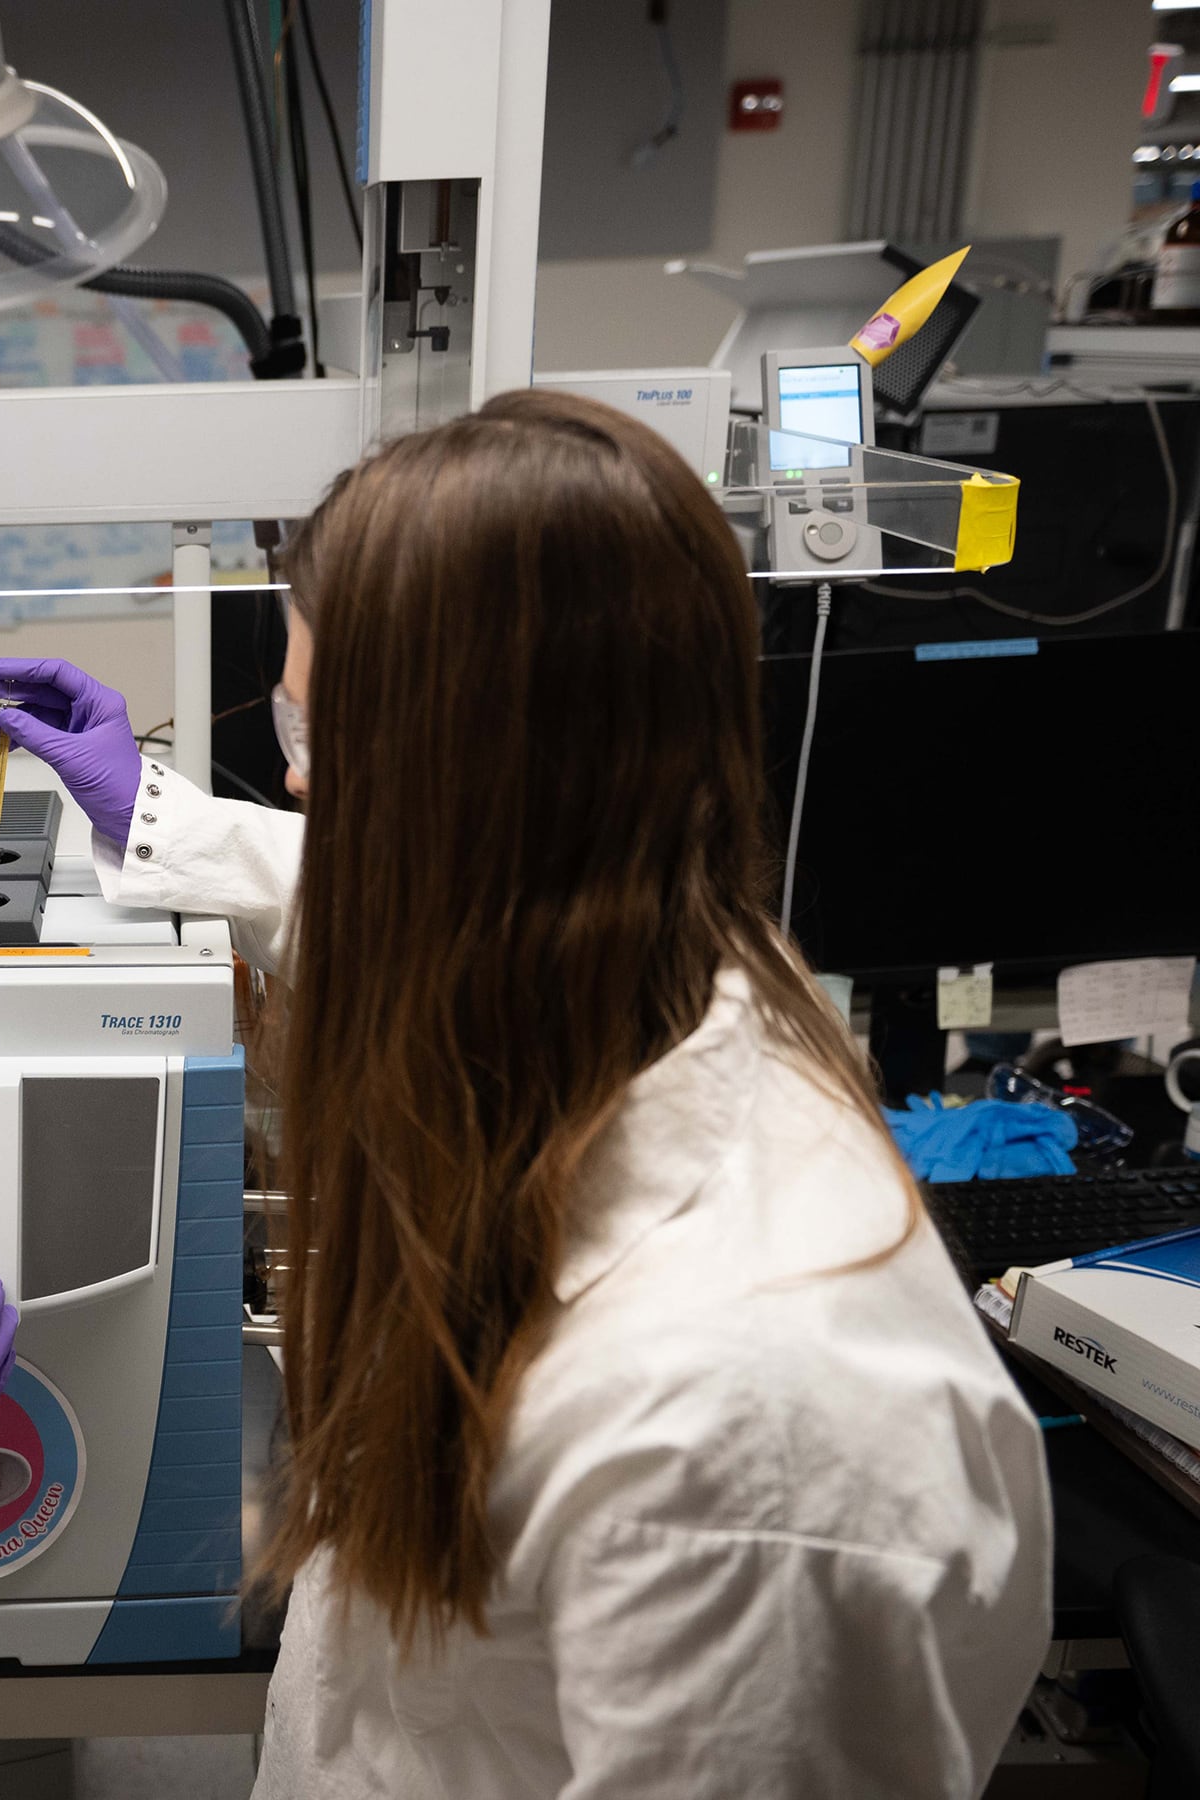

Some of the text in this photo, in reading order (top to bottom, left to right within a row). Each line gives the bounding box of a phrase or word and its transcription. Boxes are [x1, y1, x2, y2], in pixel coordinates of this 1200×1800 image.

[676, 389, 693, 400] 100
[149, 1015, 182, 1028] 1310
[134, 1028, 180, 1036] Chromatograph
[1054, 1326, 1118, 1374] RESTEK
[19, 1482, 64, 1540] Queen
